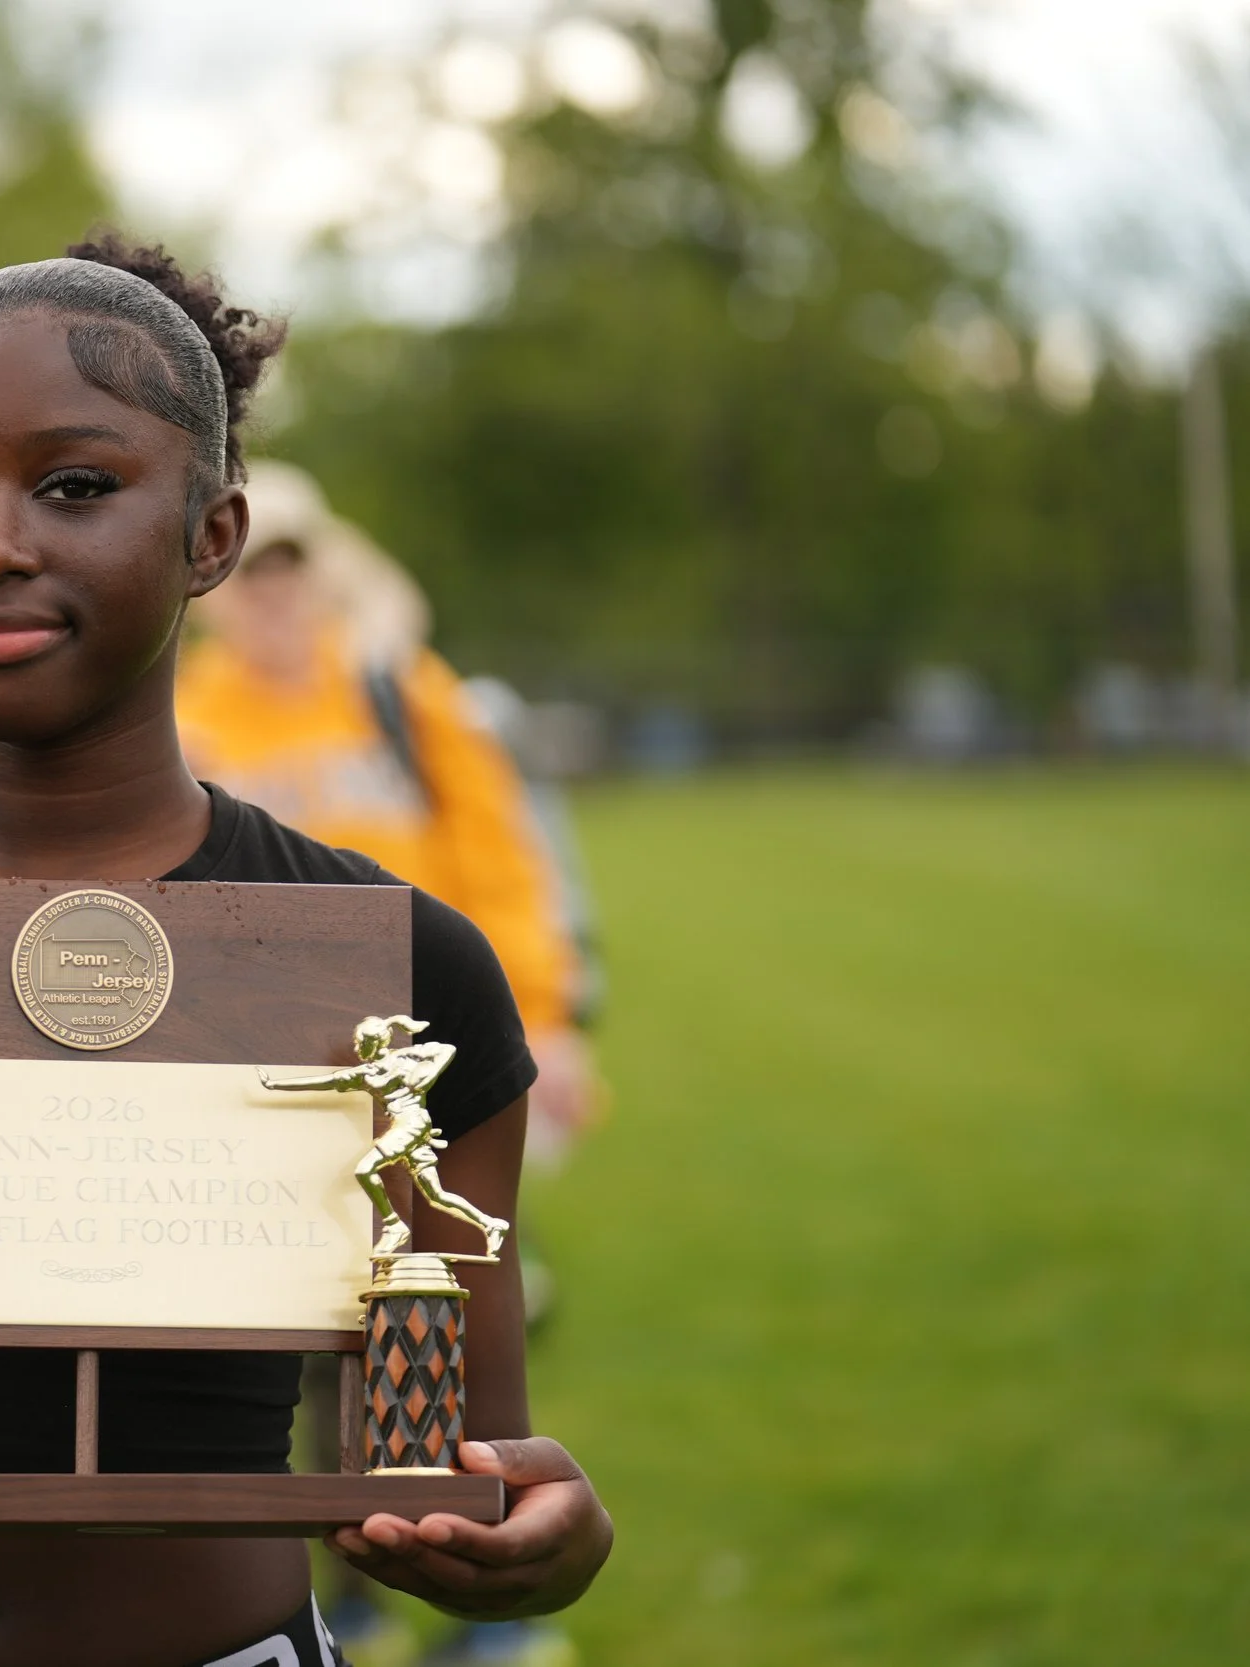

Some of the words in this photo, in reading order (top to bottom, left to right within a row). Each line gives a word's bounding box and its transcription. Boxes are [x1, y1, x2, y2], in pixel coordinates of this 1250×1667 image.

[45, 897, 81, 918] SOCCER
[84, 896, 136, 916] X-COUNTRY
[23, 917, 46, 948] TENNIS
[136, 914, 166, 968] BASKETBALL
[60, 951, 108, 966] Penn
[18, 950, 36, 1008] VOLLEYBALL
[92, 973, 154, 993] Jersey
[42, 993, 81, 1004] Athletic
[83, 993, 121, 1006] League
[144, 971, 167, 1016] SOFTBALL
[35, 1009, 60, 1033] FIELD
[60, 1026, 67, 1036] &
[72, 1015, 117, 1025] est.1991
[106, 1015, 148, 1042] BASEBALL
[69, 1032, 101, 1044] TRACK
[40, 1094, 146, 1123] 2026
[75, 1176, 305, 1207] CHAMPION
[119, 1218, 330, 1248] FOOTBALL
